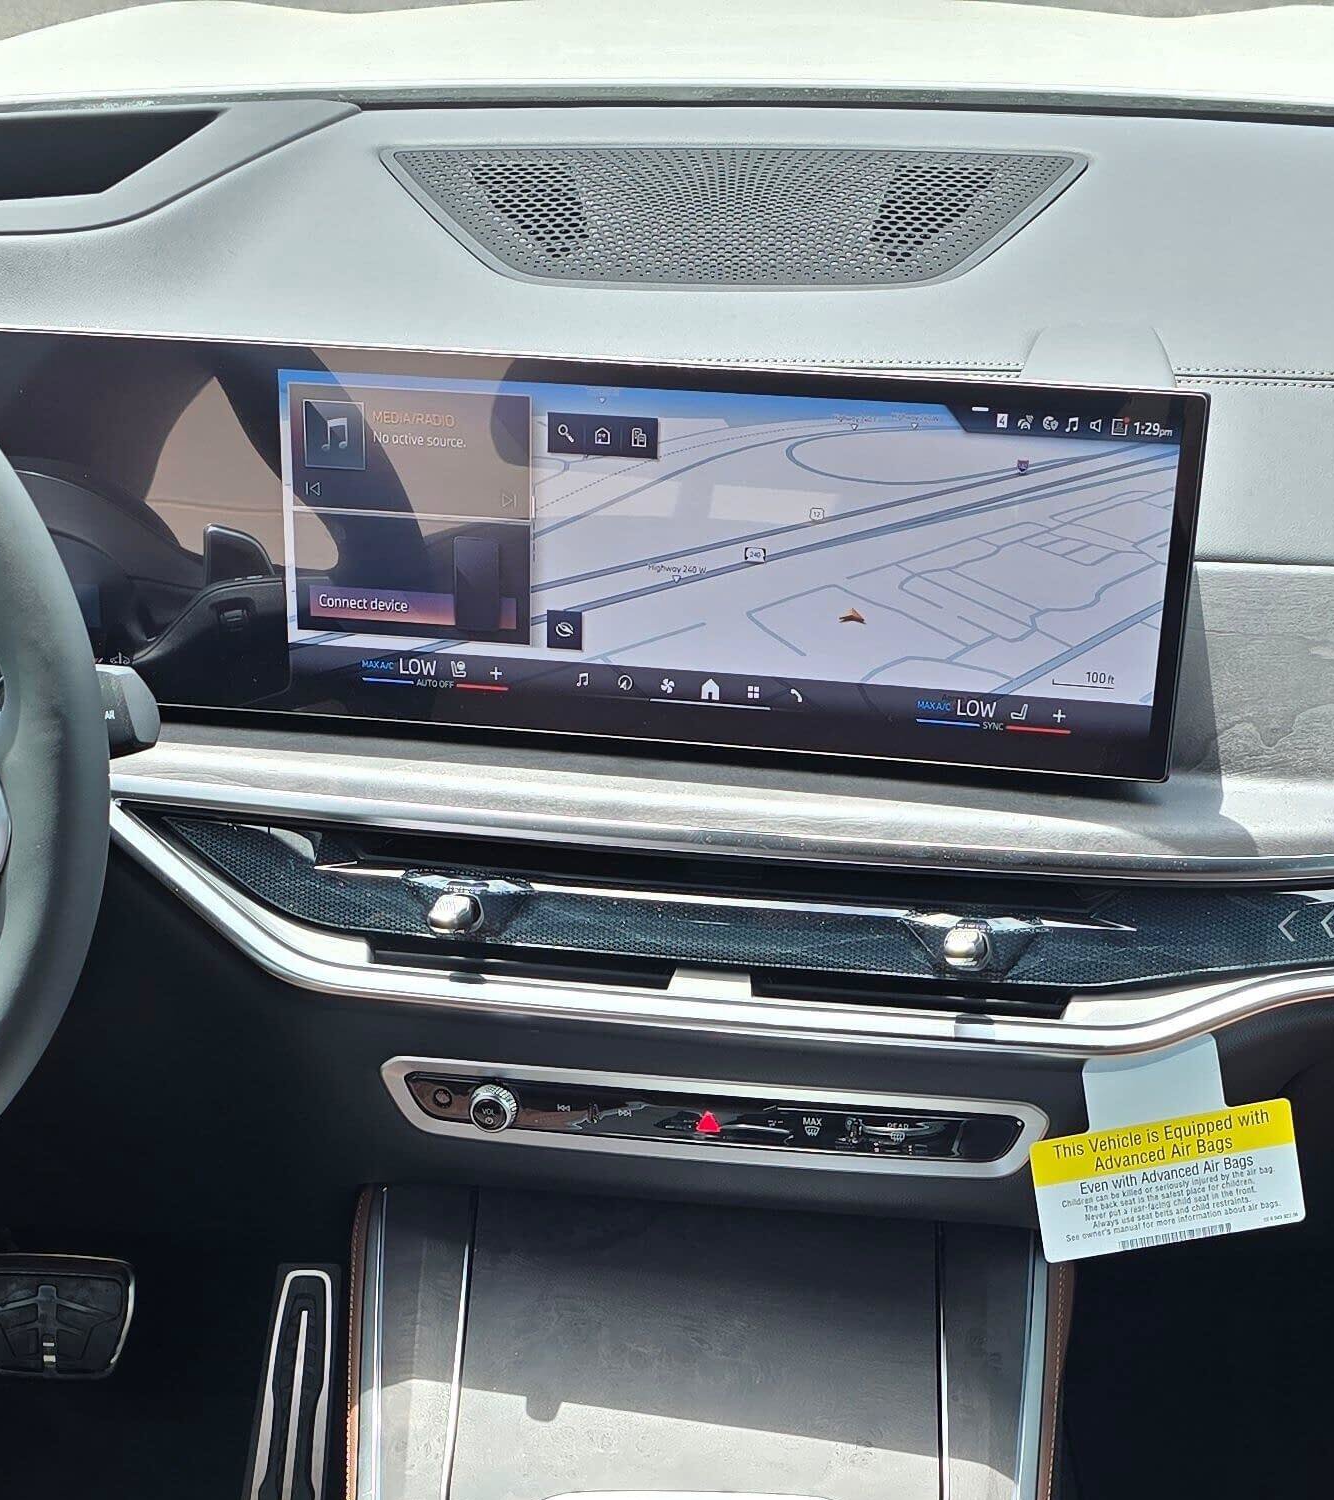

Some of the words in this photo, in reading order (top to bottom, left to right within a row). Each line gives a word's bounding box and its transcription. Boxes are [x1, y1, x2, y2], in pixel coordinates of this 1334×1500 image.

[373, 411, 455, 428] MEDIA/RADIO
[373, 431, 389, 444] No
[392, 433, 424, 446] active
[427, 437, 467, 449] source.
[648, 563, 682, 574] Highway
[683, 564, 697, 574] 240
[319, 594, 368, 610] Connect
[370, 597, 408, 612] device
[361, 660, 379, 669] MAX
[399, 658, 437, 676] LOW
[416, 678, 438, 688] AUTO
[439, 680, 455, 689] OFF
[1085, 671, 1106, 684] 100
[1107, 675, 1115, 685] ft
[917, 701, 935, 710] MAX
[956, 699, 996, 718] LOW
[982, 721, 1004, 731] SYNC
[482, 1108, 495, 1116] VOL
[802, 1117, 822, 1127] MAX
[1054, 1143, 1085, 1160] This
[1088, 1132, 1142, 1153] Vehicle
[1147, 1129, 1160, 1143] is
[1164, 1115, 1233, 1142] Equipped
[1238, 1109, 1270, 1127] with
[1095, 1148, 1166, 1171] Advanced
[1171, 1143, 1192, 1158] Air
[1198, 1137, 1233, 1154] Bags
[1079, 1181, 1109, 1196] Even
[1112, 1175, 1138, 1190] with
[1141, 1163, 1200, 1185] Advanced
[1203, 1160, 1221, 1174] Air
[1224, 1155, 1254, 1171] Bags
[1062, 1197, 1094, 1208] Children
[1096, 1194, 1108, 1202] can
[1111, 1191, 1120, 1199] be
[1122, 1187, 1143, 1197] killed
[1155, 1179, 1189, 1191] seriously
[1192, 1174, 1218, 1185] injured
[1221, 1171, 1230, 1181] by
[1232, 1169, 1244, 1178] the
[1246, 1166, 1257, 1176] air
[1084, 1204, 1098, 1213] The
[1101, 1199, 1117, 1210] back
[1120, 1197, 1136, 1206] seat
[1147, 1193, 1159, 1201] the
[1161, 1189, 1184, 1199] safest
[1187, 1187, 1206, 1197] place
[1208, 1183, 1219, 1192] for
[1084, 1212, 1106, 1221] Never
[1109, 1209, 1121, 1218] put
[1130, 1199, 1171, 1214] rear-facing
[1173, 1195, 1191, 1206] child
[1194, 1193, 1209, 1203] seat
[1221, 1189, 1233, 1198] the
[1066, 1234, 1080, 1243] See
[1082, 1228, 1111, 1240] owner's
[1113, 1223, 1141, 1234] manual
[1143, 1220, 1154, 1229] for
[1156, 1217, 1176, 1226] more
[1178, 1210, 1222, 1222] information
[1224, 1205, 1246, 1216] about
[1248, 1203, 1258, 1212] air
[1093, 1218, 1119, 1229] Always
[1122, 1216, 1135, 1224] use
[1137, 1212, 1152, 1222] seat
[1155, 1208, 1173, 1218] belts
[1175, 1206, 1189, 1215] and
[1192, 1201, 1210, 1212] child
